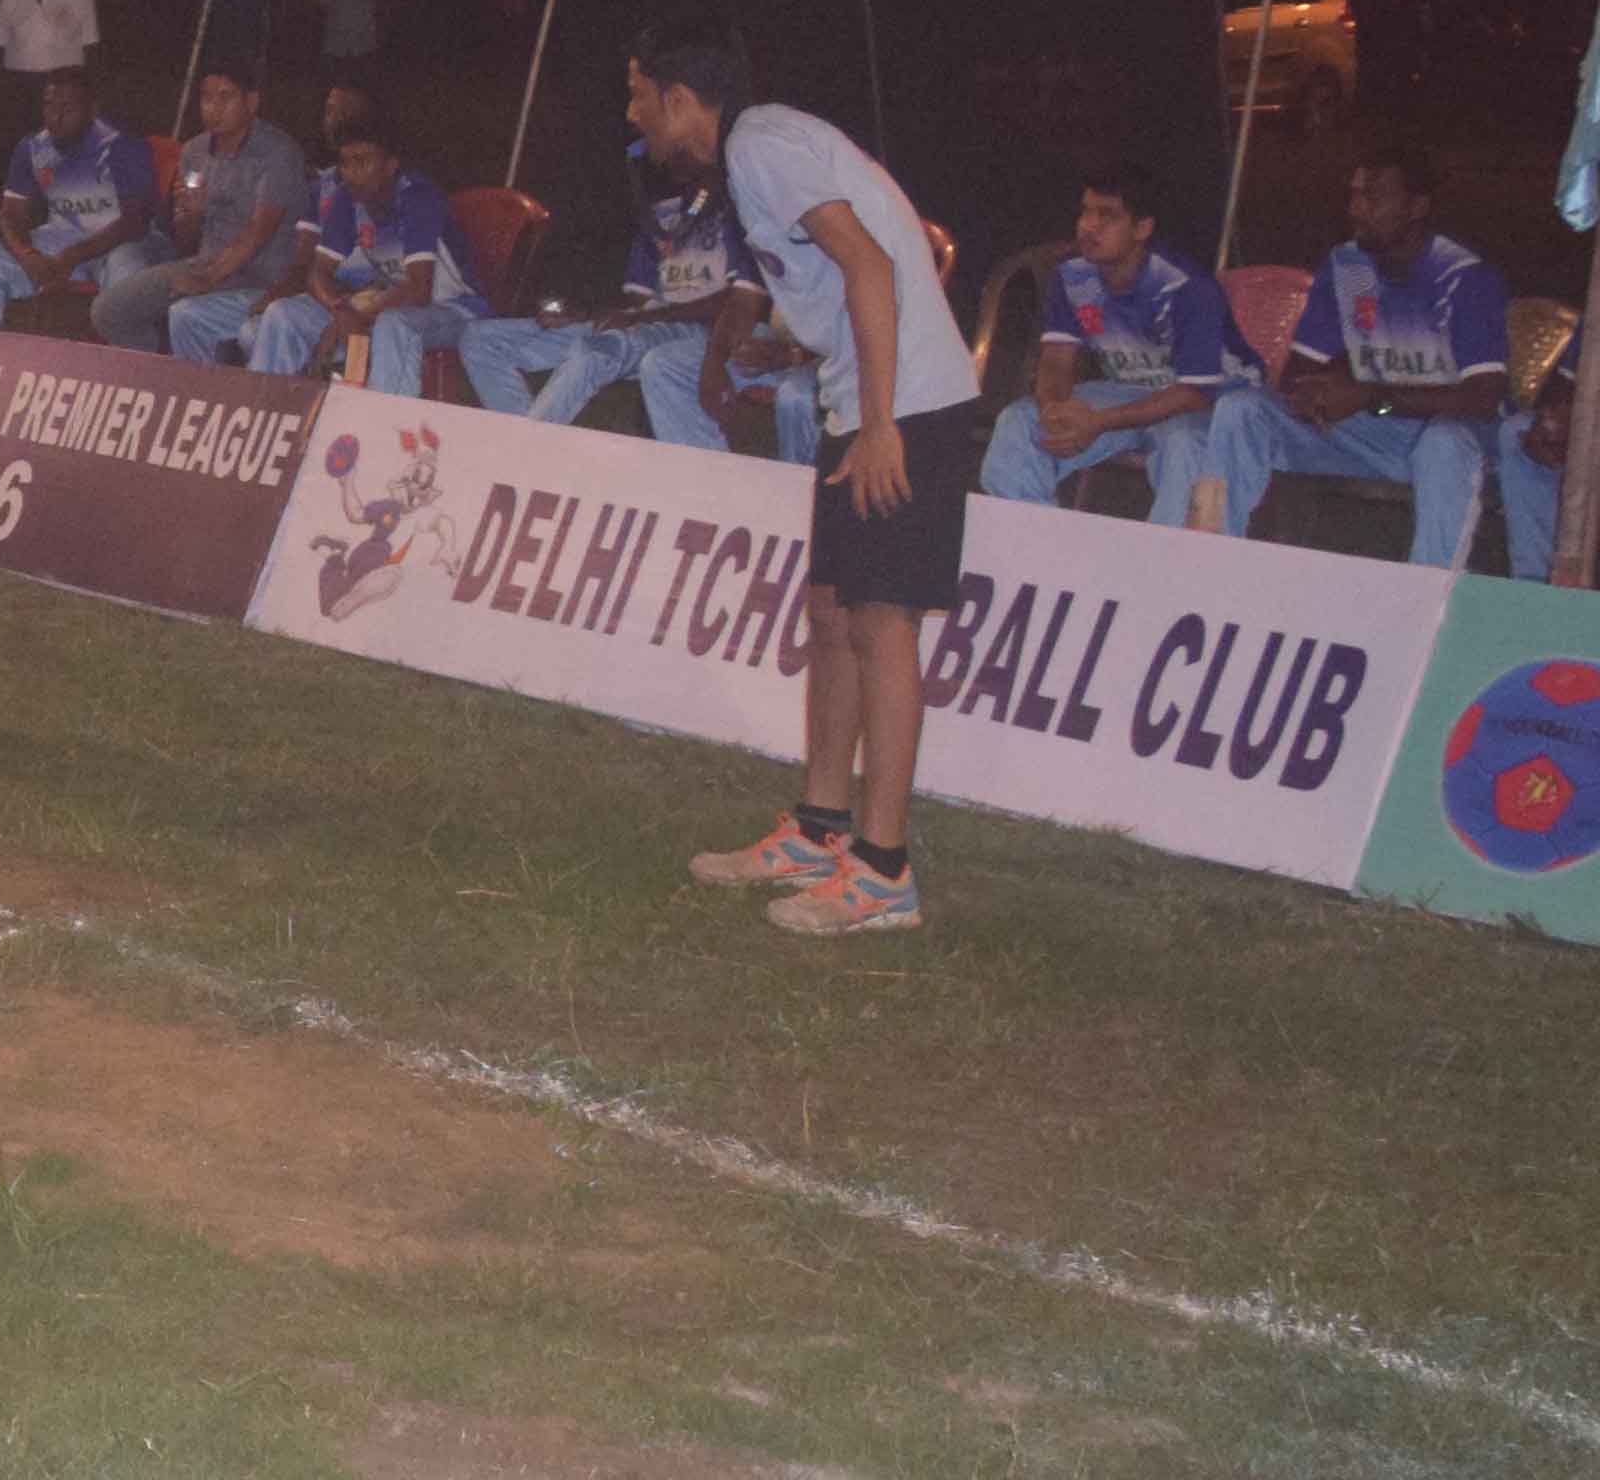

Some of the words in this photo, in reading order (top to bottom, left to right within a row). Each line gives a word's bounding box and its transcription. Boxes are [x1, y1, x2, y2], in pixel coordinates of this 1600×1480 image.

[0, 371, 155, 461] PREMIER
[147, 395, 301, 487] LEAGUE
[451, 483, 660, 636] DELHI
[649, 519, 1120, 743] TCHBALL
[1130, 612, 1368, 791] CLUB
